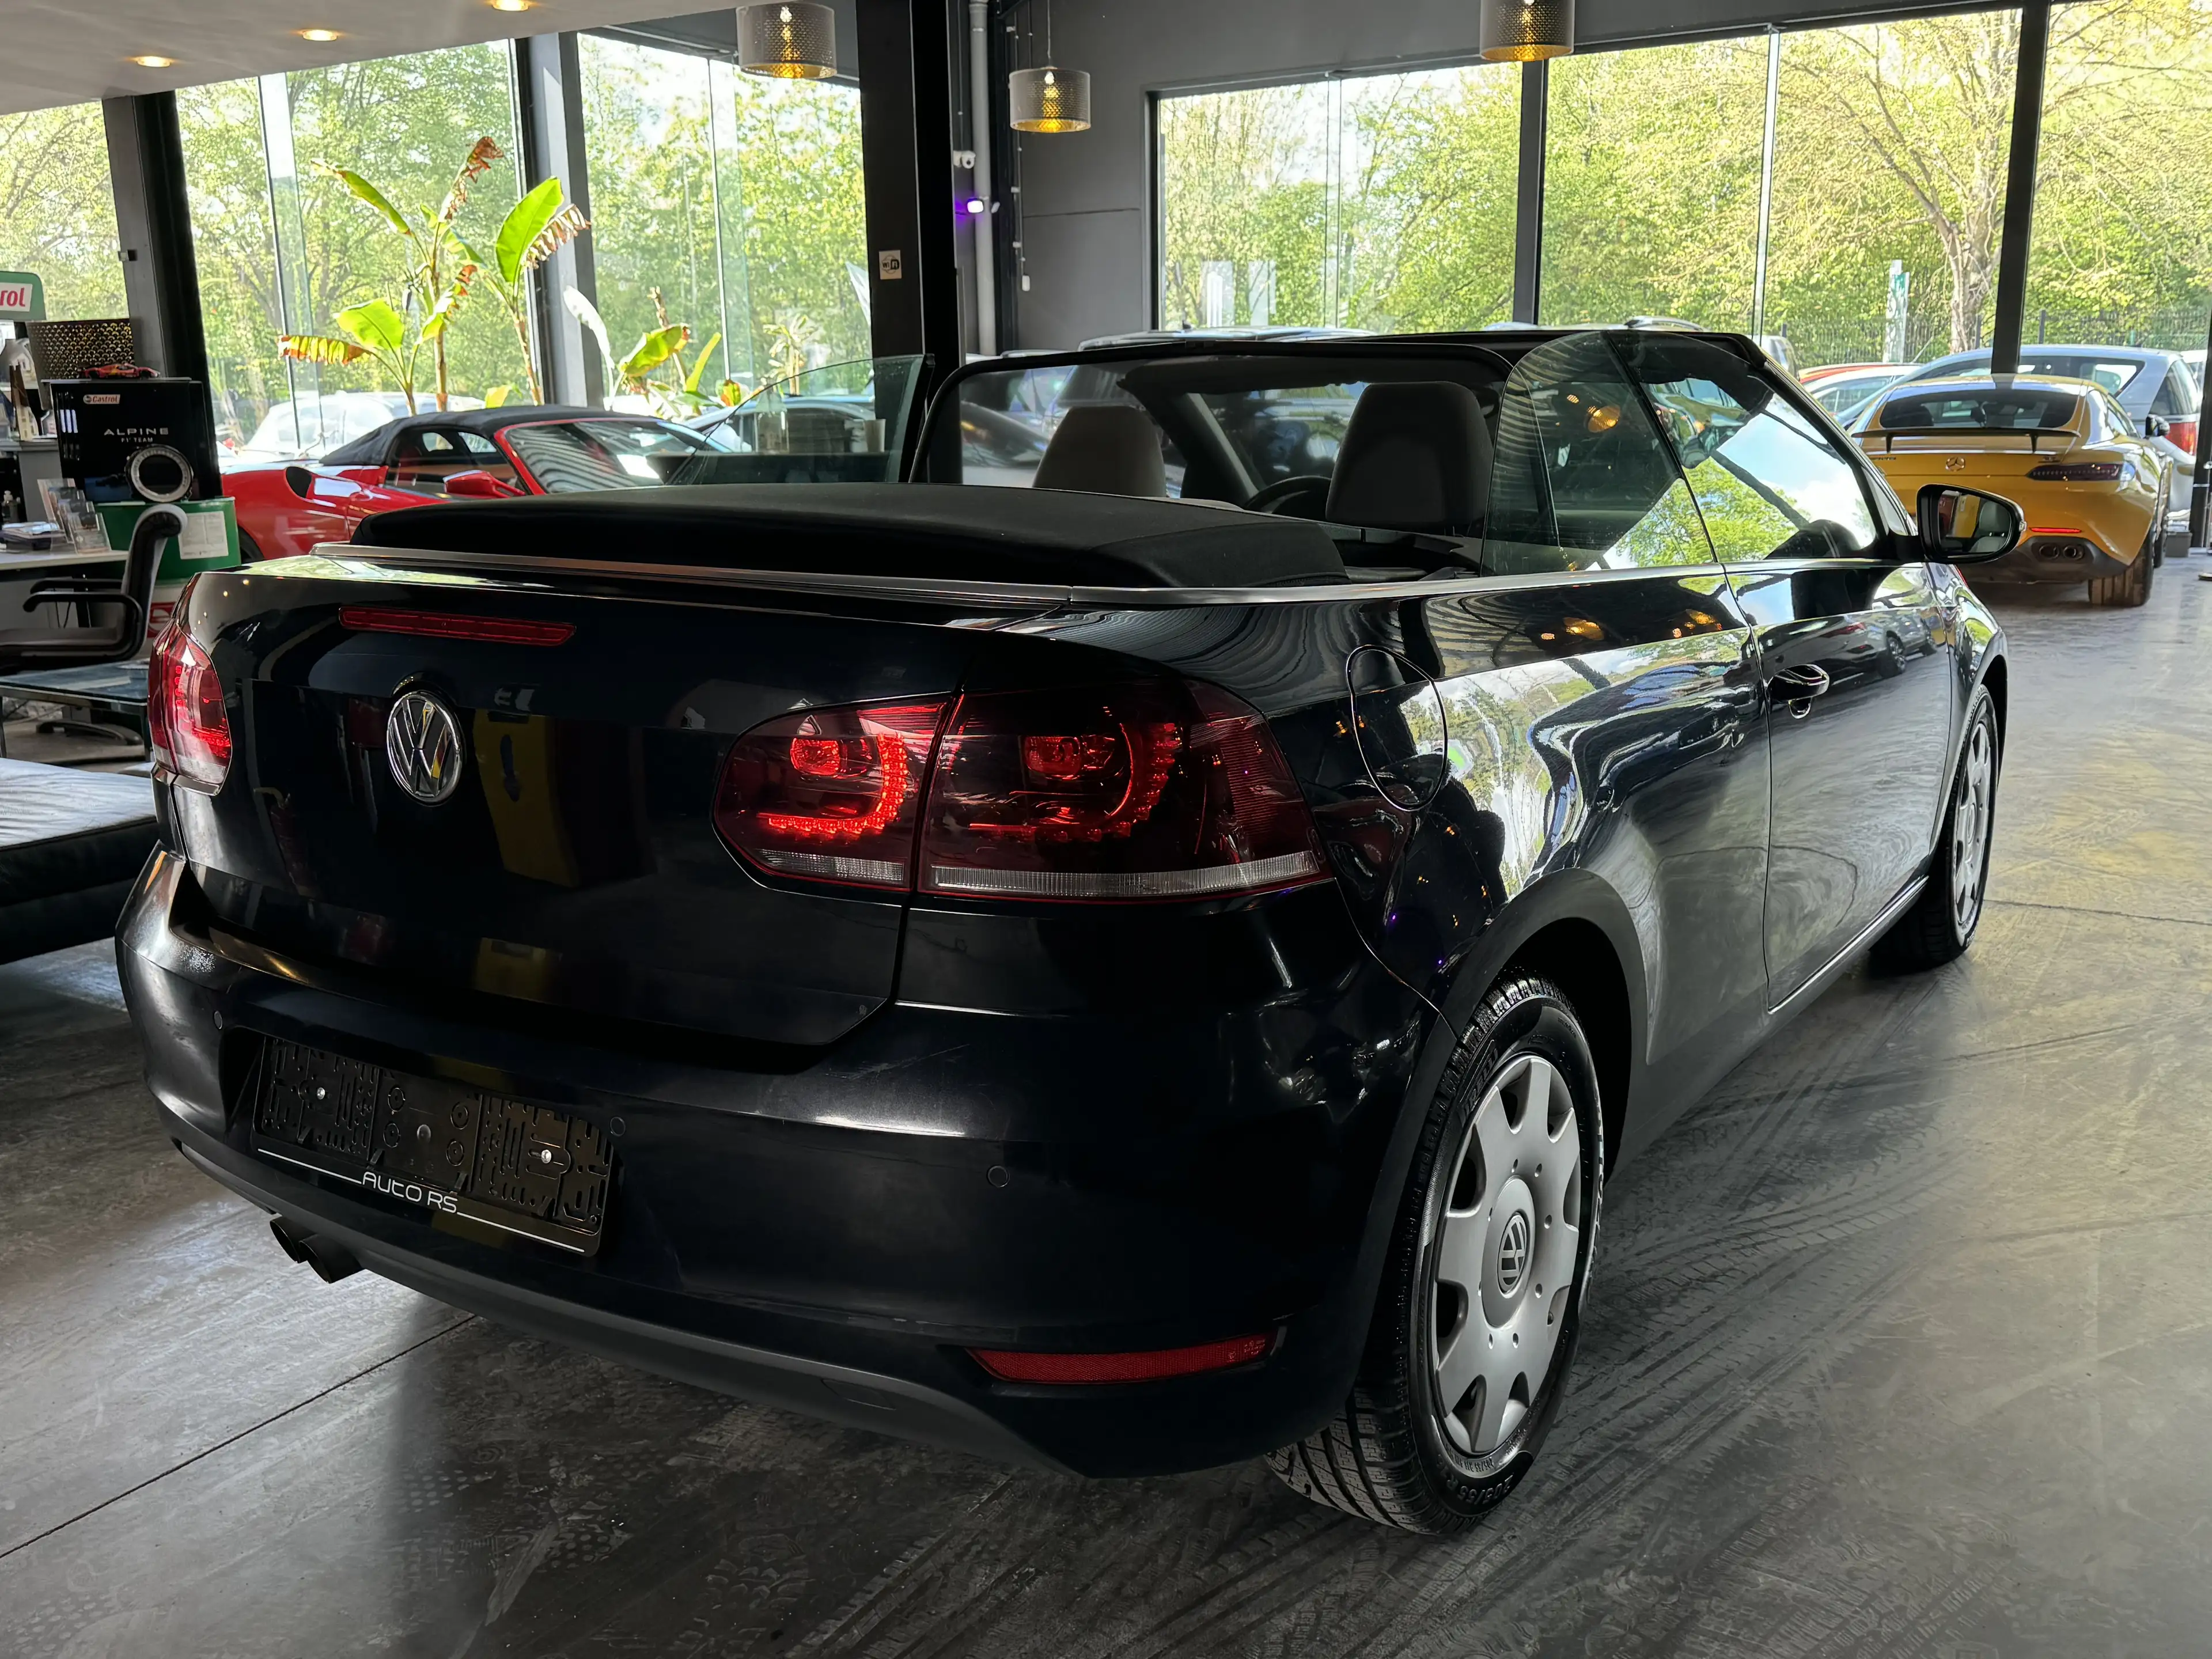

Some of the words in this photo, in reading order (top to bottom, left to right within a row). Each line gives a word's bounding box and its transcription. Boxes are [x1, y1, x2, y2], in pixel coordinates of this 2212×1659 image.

[0, 287, 26, 307] rol
[104, 427, 169, 435] ALPINE
[427, 1190, 459, 1213] RS
[1457, 1474, 1514, 1505] 205/55
